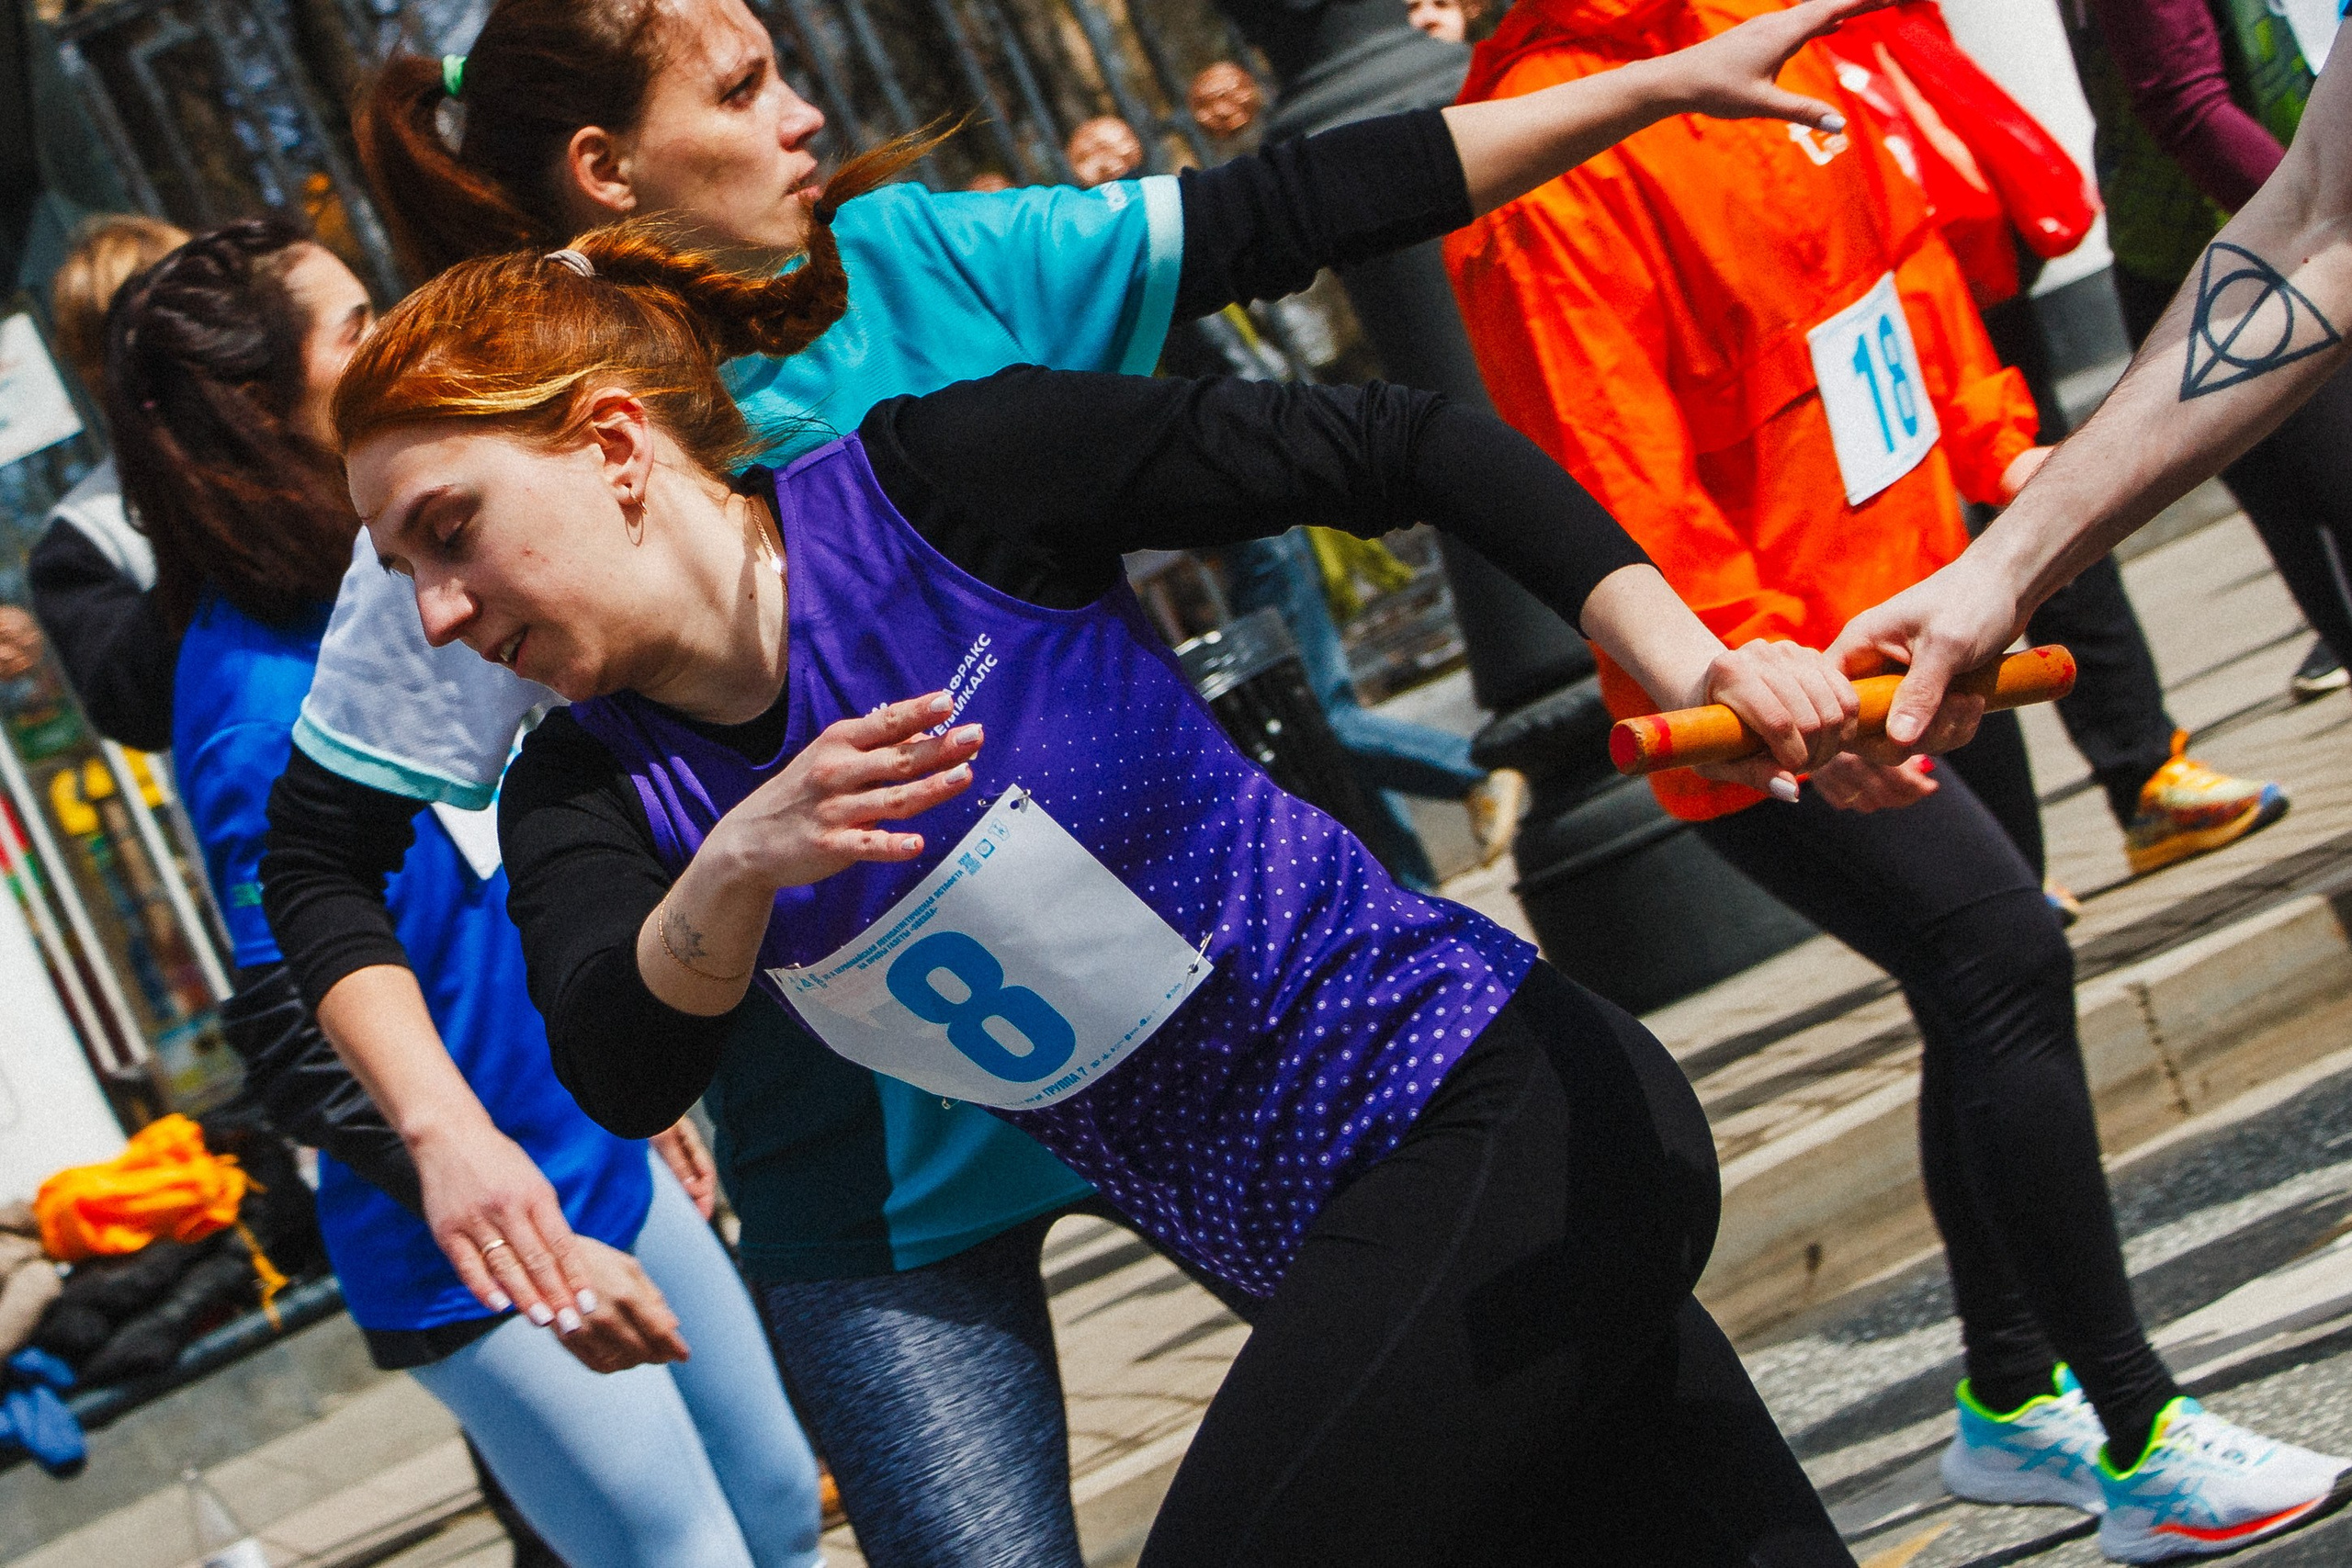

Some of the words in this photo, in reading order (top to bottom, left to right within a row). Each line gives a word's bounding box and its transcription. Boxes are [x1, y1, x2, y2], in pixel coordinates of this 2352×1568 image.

[1852, 311, 1918, 454] 18
[887, 931, 1076, 1083] 8
[1043, 1073, 1081, 1097] ГРУППА
[1077, 1066, 1089, 1077] 7
